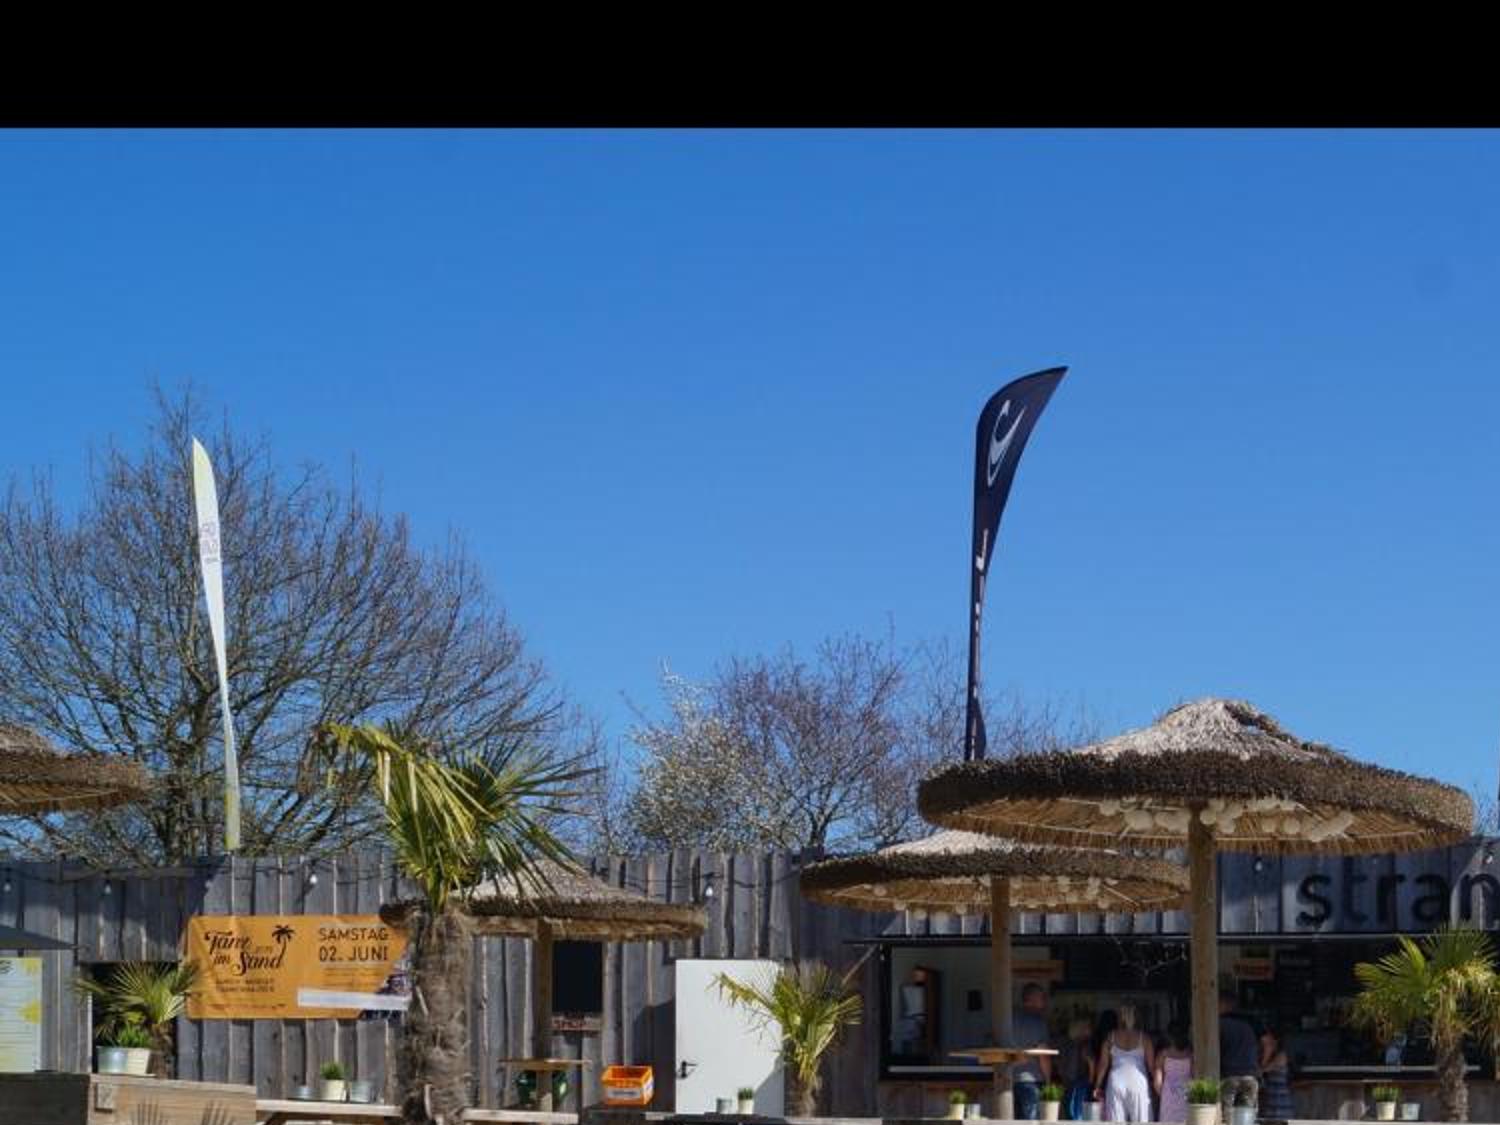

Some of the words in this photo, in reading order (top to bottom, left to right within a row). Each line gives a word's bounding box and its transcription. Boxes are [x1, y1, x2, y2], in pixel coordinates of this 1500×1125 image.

[319, 927, 389, 941] SAMSTAG
[319, 945, 344, 962] 02.
[348, 945, 388, 961] JUNI
[231, 949, 286, 976] Sand
